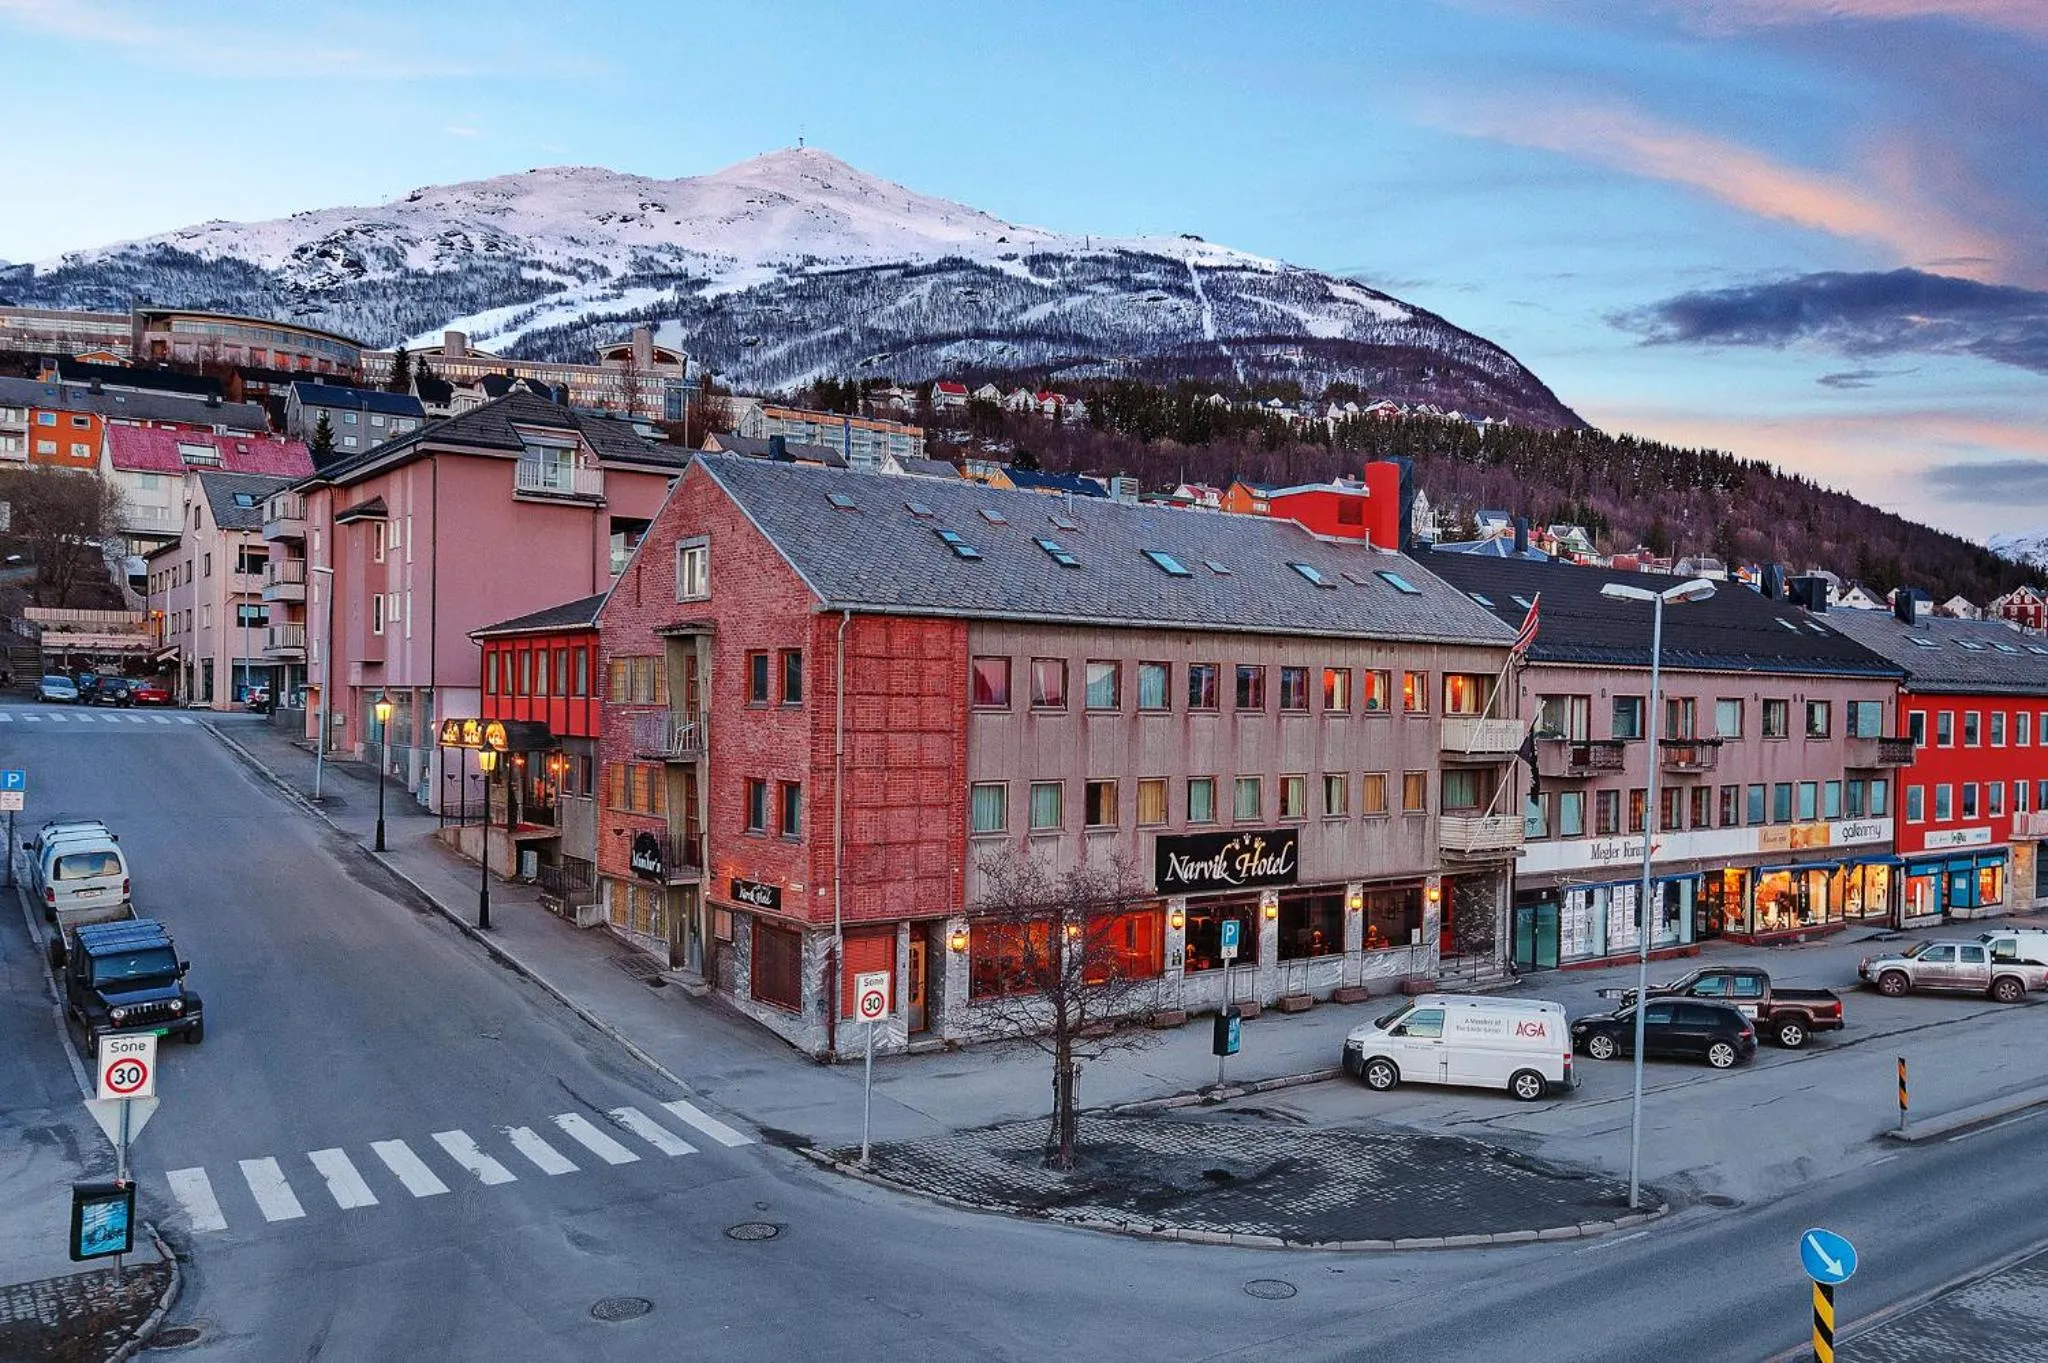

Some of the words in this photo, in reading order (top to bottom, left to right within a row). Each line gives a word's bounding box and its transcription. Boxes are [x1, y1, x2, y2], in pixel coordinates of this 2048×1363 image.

[8, 773, 20, 788] P
[1590, 842, 1620, 864] Megler
[1164, 843, 1246, 884] Narvik
[1235, 841, 1295, 878] Hotel
[1226, 924, 1235, 942] P
[865, 997, 880, 1011] 30
[1515, 1020, 1546, 1037] AGA
[111, 1042, 147, 1053] Sone
[114, 1067, 140, 1085] 30
